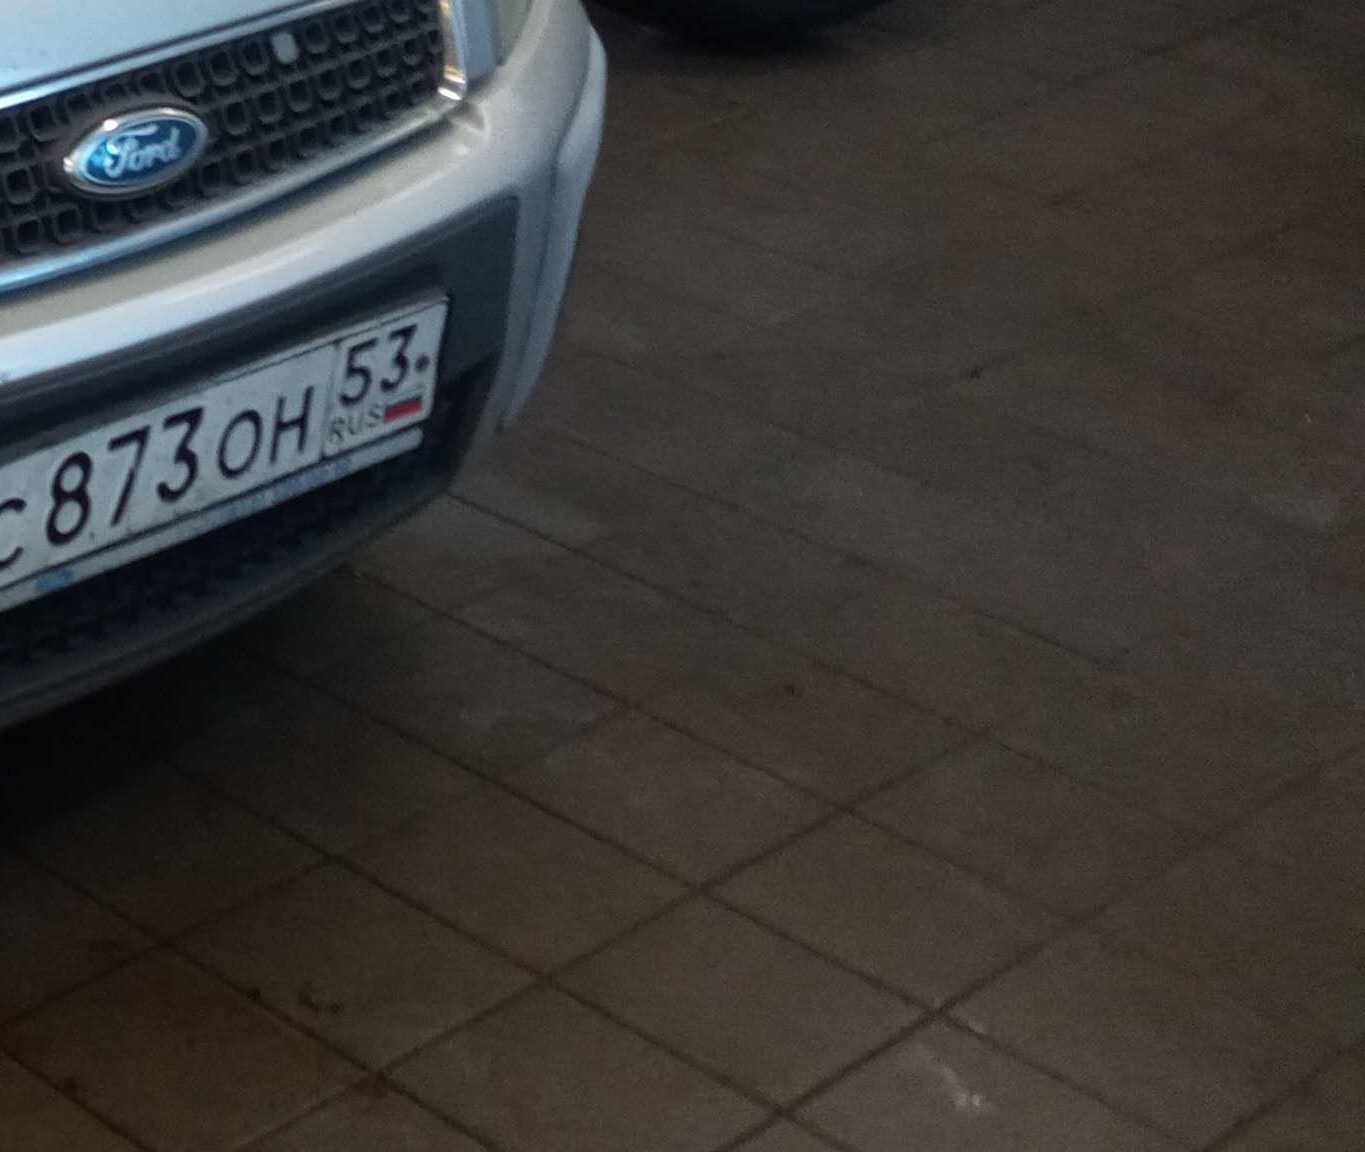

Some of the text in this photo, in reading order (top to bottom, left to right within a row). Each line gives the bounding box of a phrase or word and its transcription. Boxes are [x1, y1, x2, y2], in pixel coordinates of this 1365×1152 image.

[103, 123, 181, 179] Ford
[338, 323, 418, 407] 53
[328, 401, 383, 443] RUS
